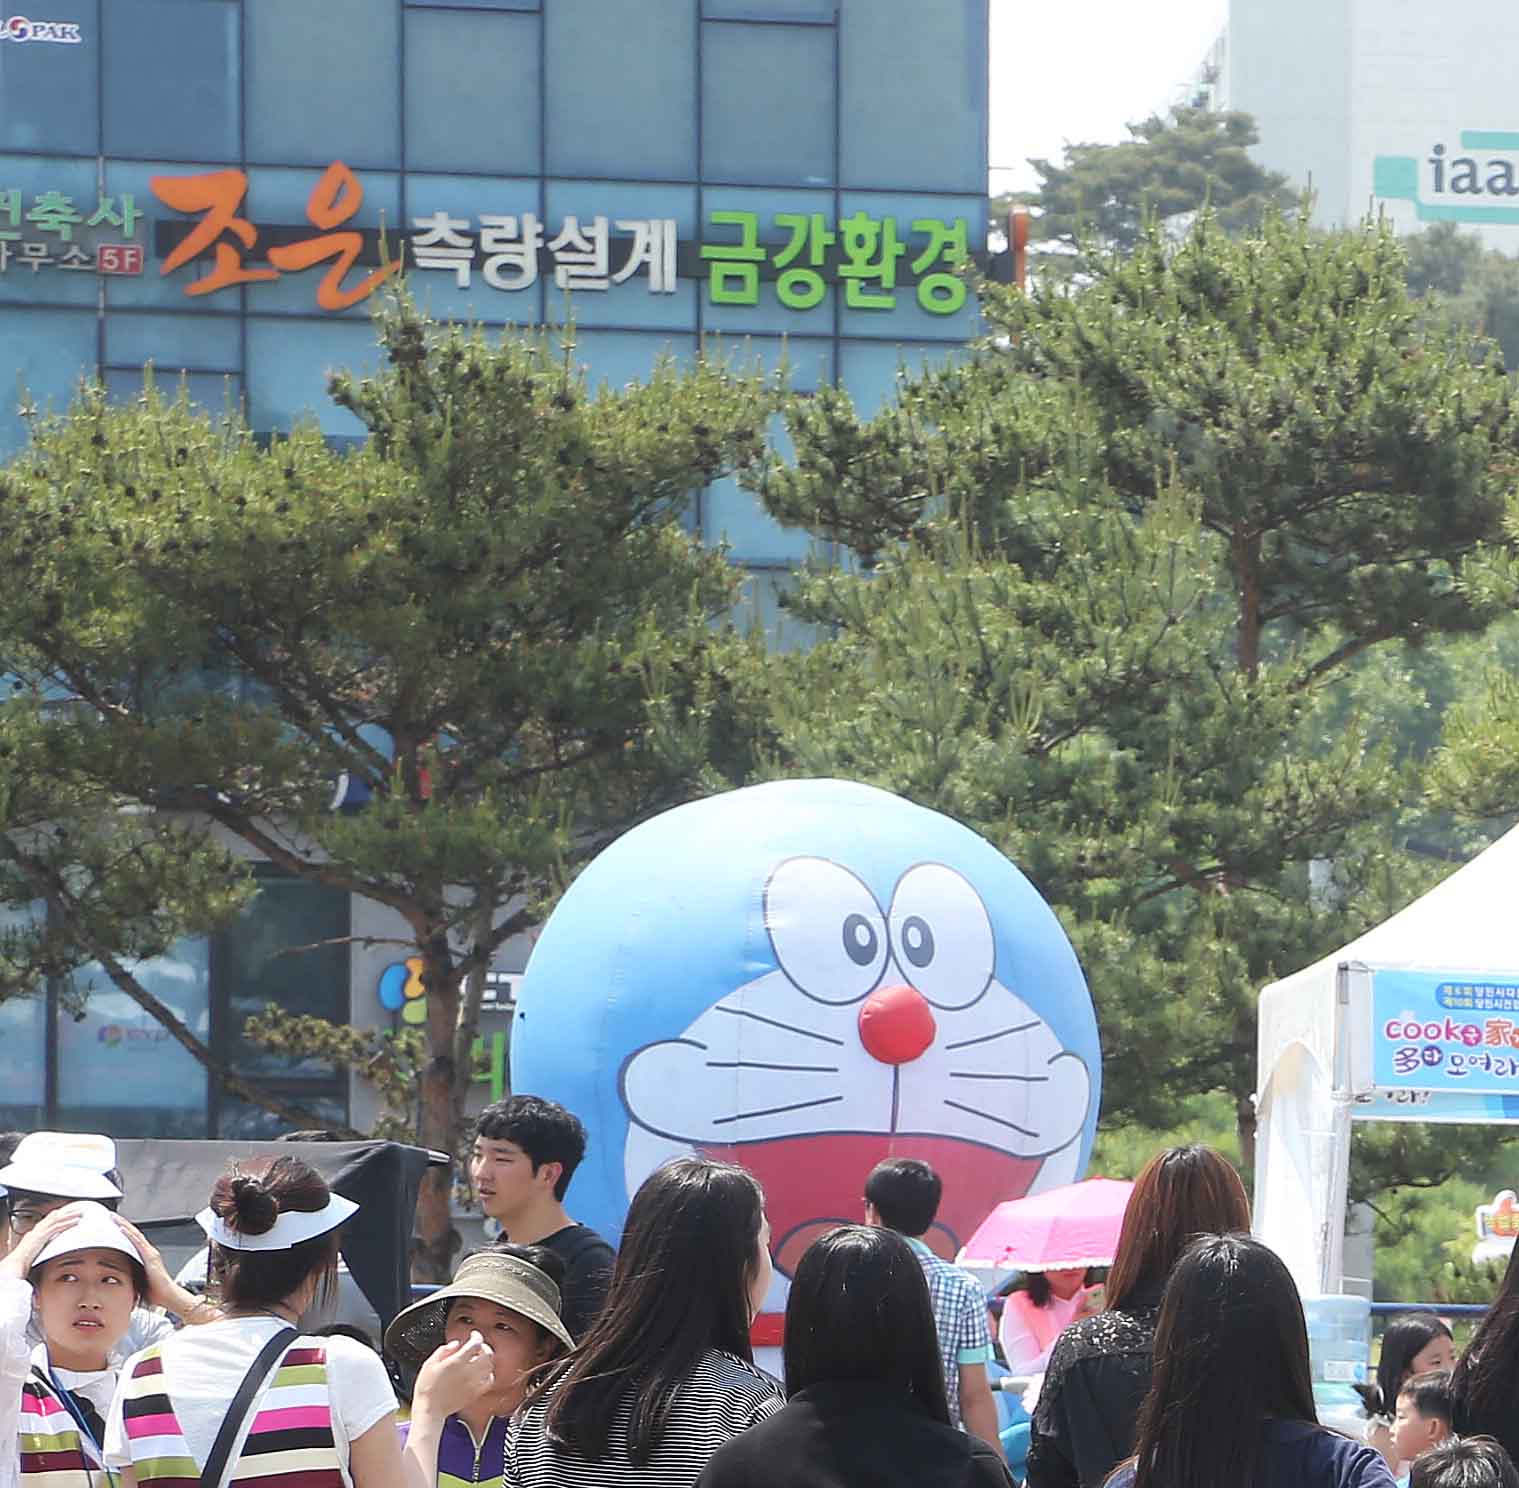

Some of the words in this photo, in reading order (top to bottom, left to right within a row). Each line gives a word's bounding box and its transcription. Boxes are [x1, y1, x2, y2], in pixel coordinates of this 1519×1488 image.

[0, 242, 97, 273] 무소
[103, 250, 137, 269] 5F
[149, 160, 403, 311] 조은
[411, 211, 677, 293] 측량설계
[699, 211, 969, 315] 금강환경
